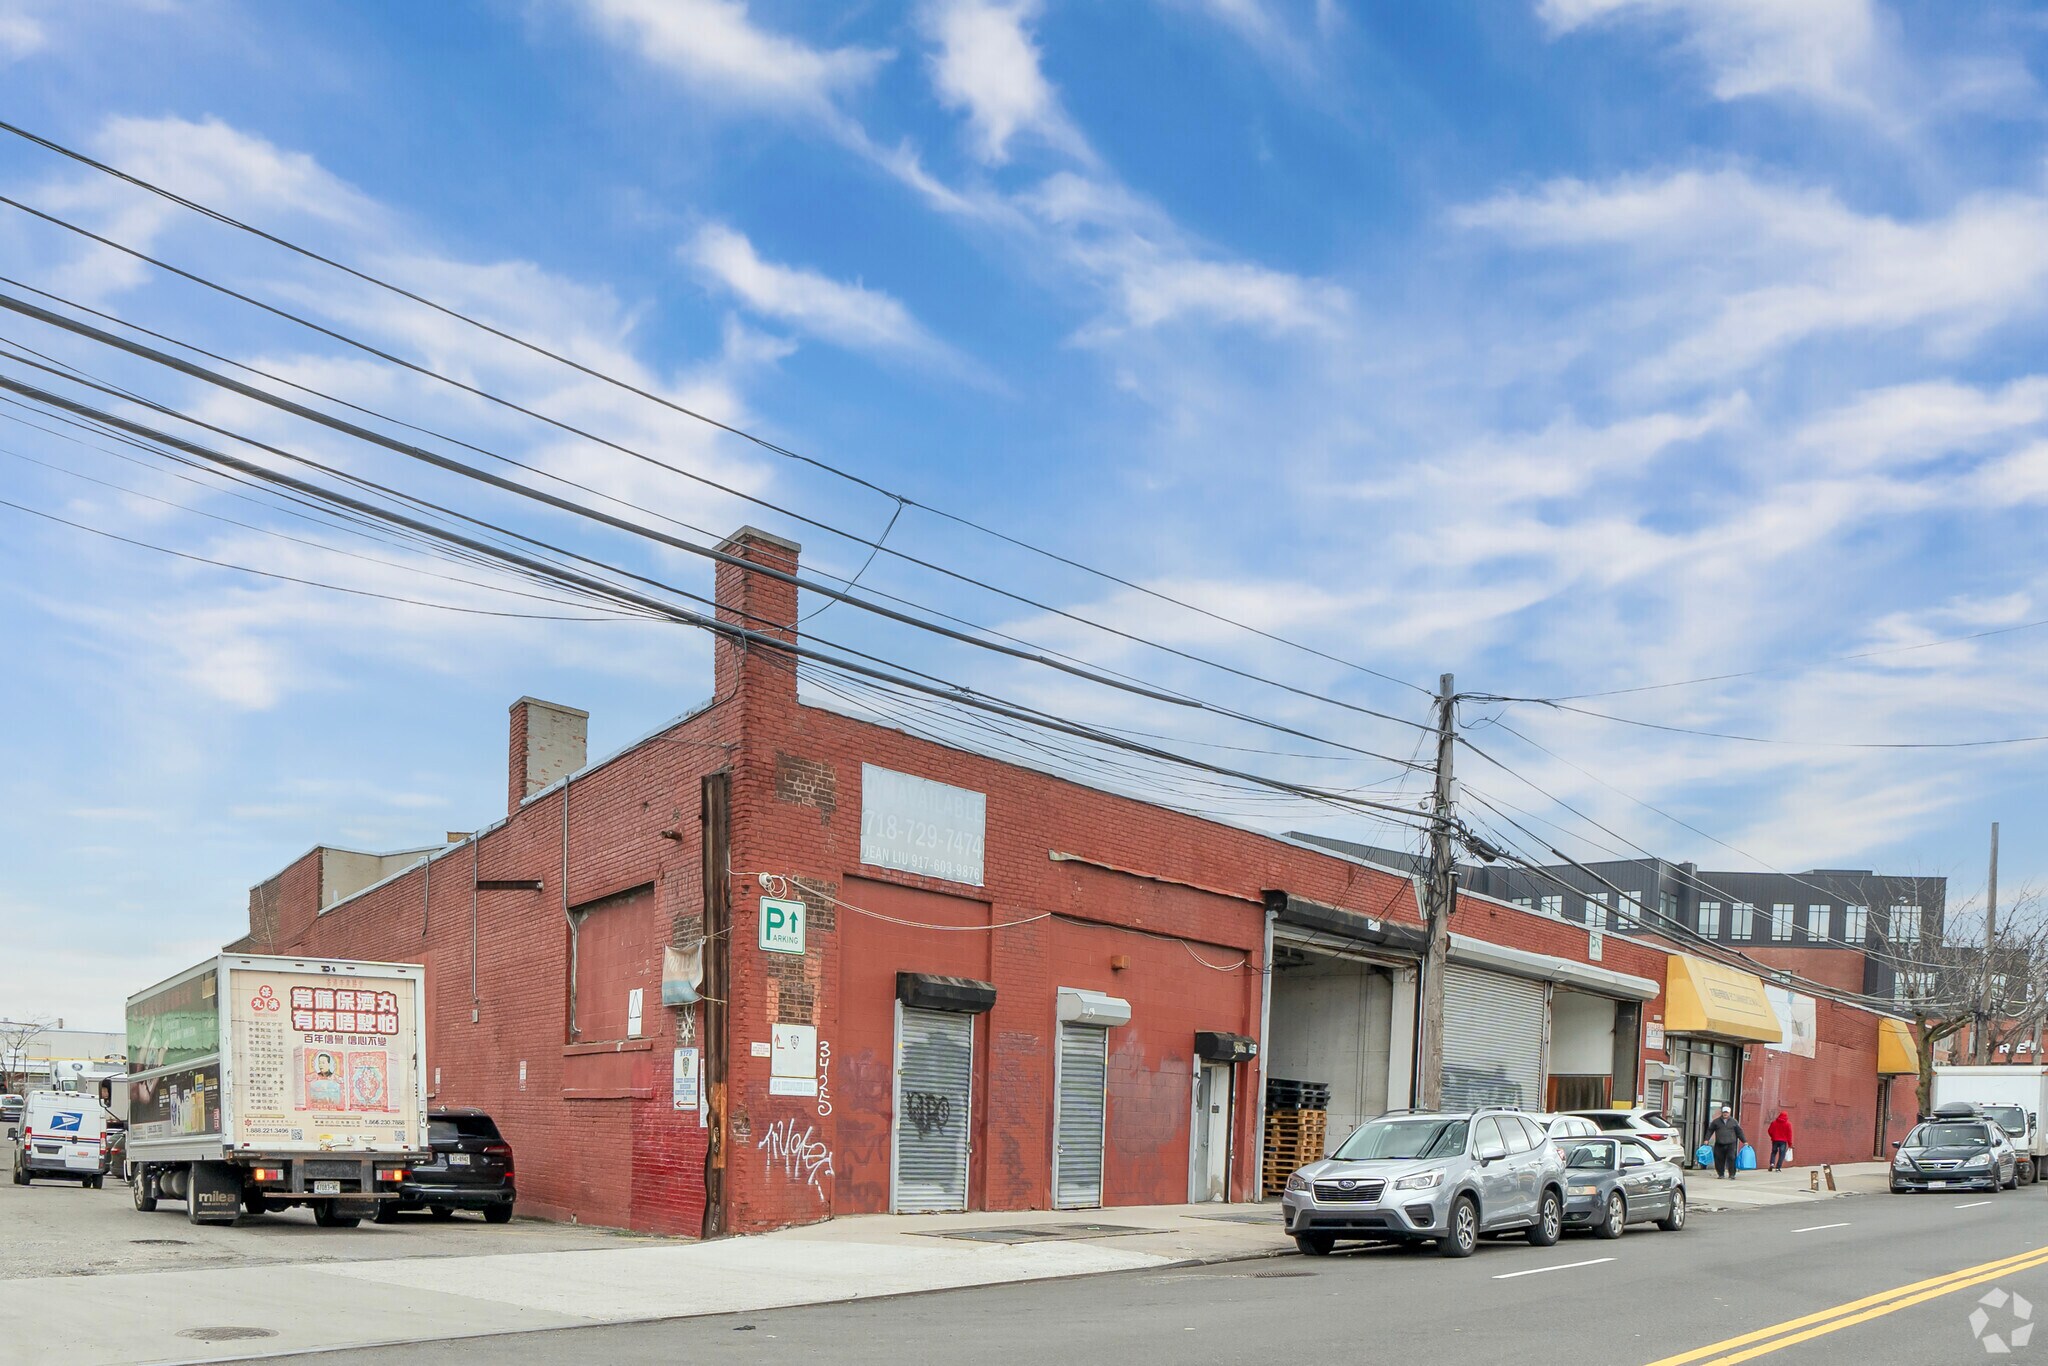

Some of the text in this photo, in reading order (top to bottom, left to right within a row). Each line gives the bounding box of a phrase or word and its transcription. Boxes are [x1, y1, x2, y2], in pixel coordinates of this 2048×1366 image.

[897, 781, 984, 824] AVAILABLE
[862, 809, 982, 859] 718-729-7474
[864, 844, 980, 881] JEAN LIU 917-603-9876
[817, 1040, 833, 1117] 3425
[198, 1190, 236, 1203] milea
